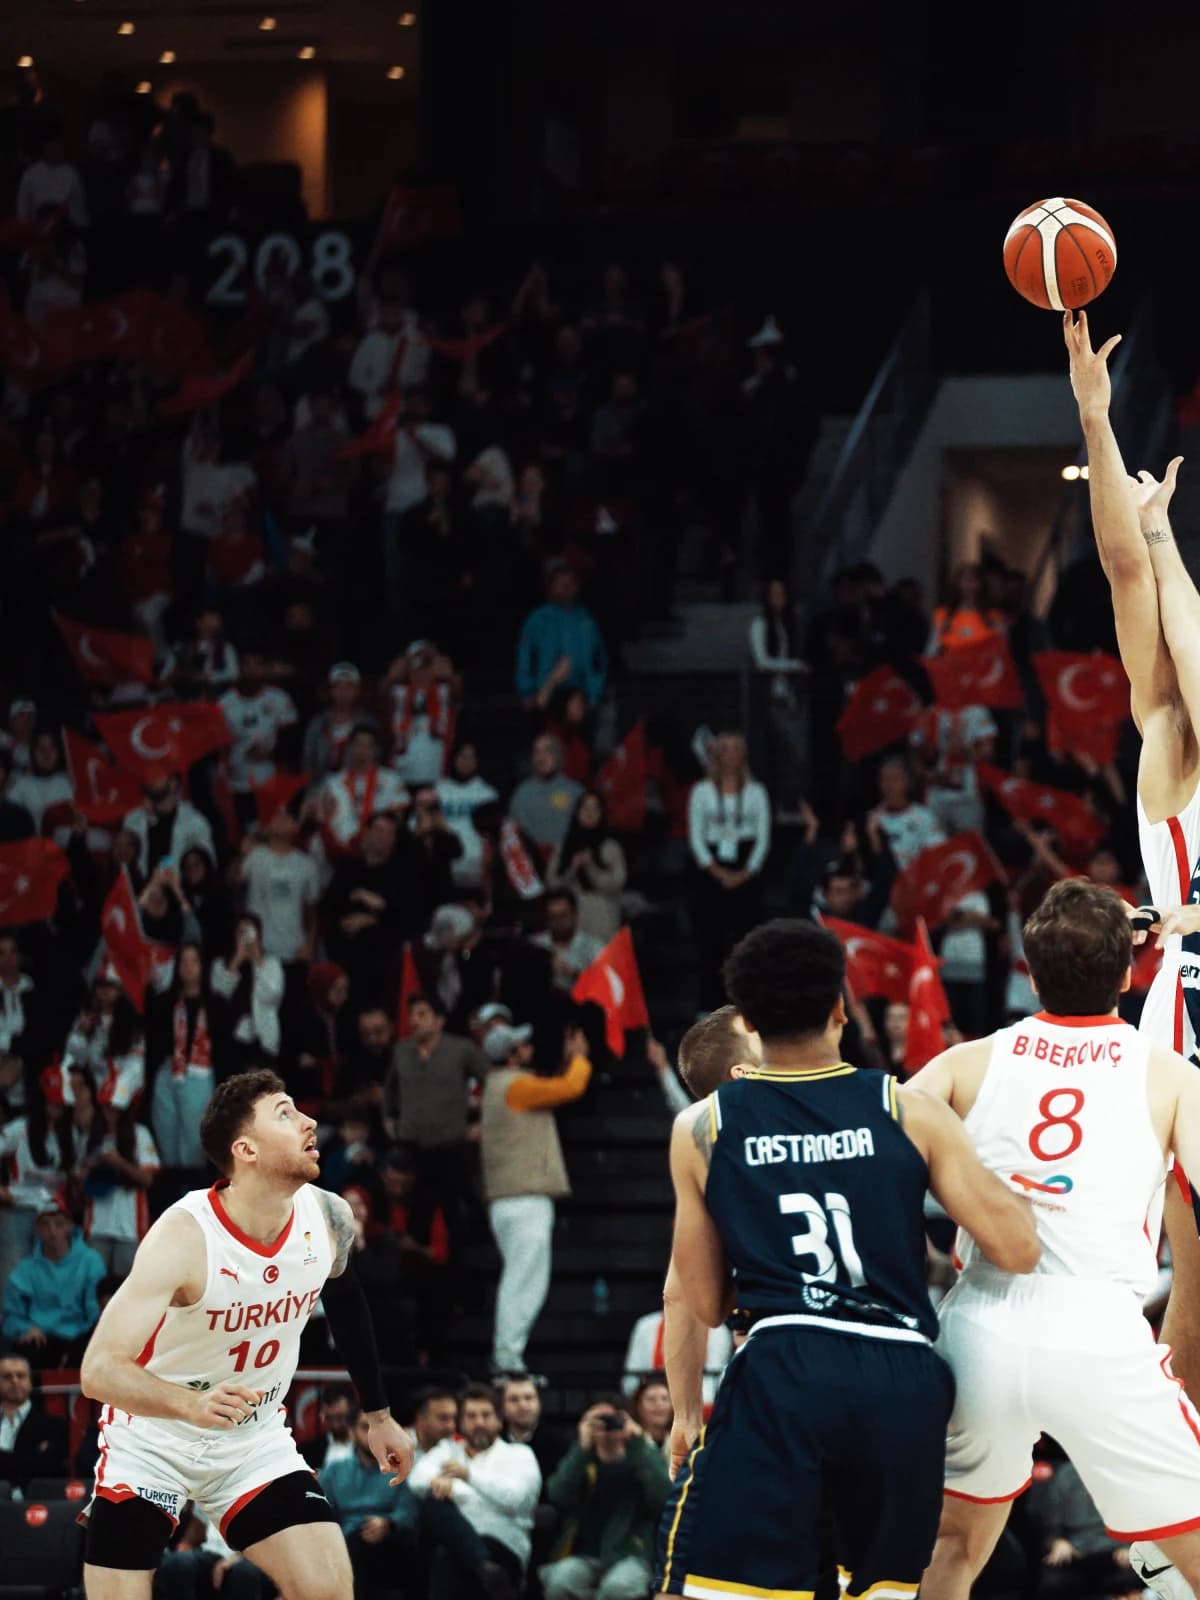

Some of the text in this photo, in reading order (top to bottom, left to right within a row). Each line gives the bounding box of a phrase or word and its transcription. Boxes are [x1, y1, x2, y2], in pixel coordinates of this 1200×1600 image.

[205, 231, 355, 305] 208
[1029, 1088, 1085, 1162] 8
[779, 1192, 868, 1288] 31
[206, 1287, 320, 1333] TÜRKİYE
[228, 1339, 280, 1373] 10
